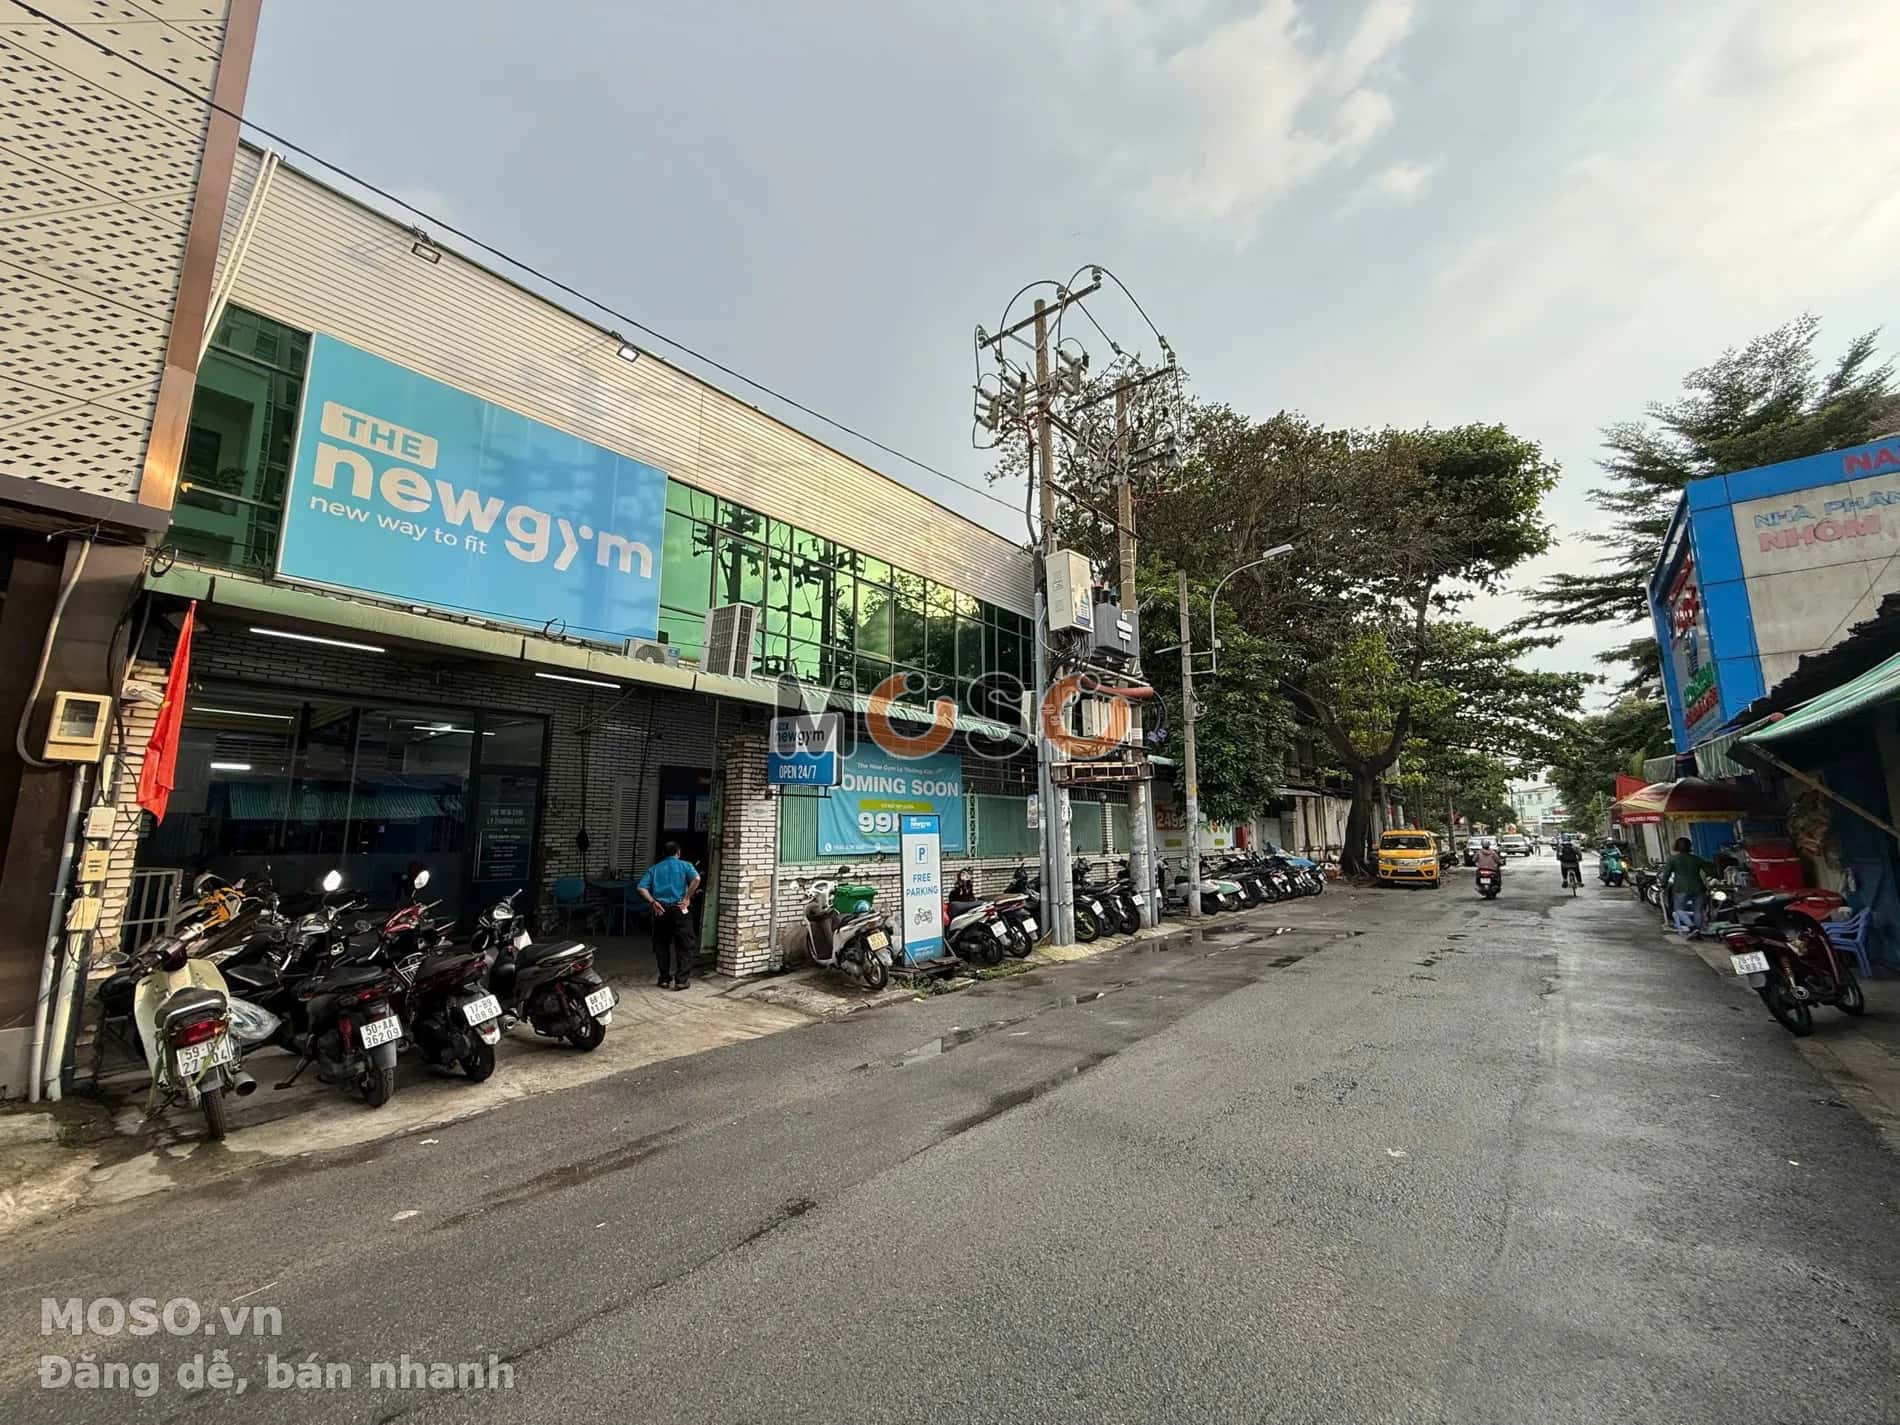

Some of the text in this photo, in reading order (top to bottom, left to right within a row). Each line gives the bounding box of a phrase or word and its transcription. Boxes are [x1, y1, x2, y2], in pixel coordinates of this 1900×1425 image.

[341, 411, 422, 460] THE
[312, 441, 653, 579] newgym
[310, 495, 488, 555] new way to fit
[779, 765, 817, 779] OPEN 24/7
[831, 774, 959, 797] OMING SOON
[918, 847, 926, 861] P
[912, 873, 932, 883] FREE
[906, 885, 939, 897] PARKING
